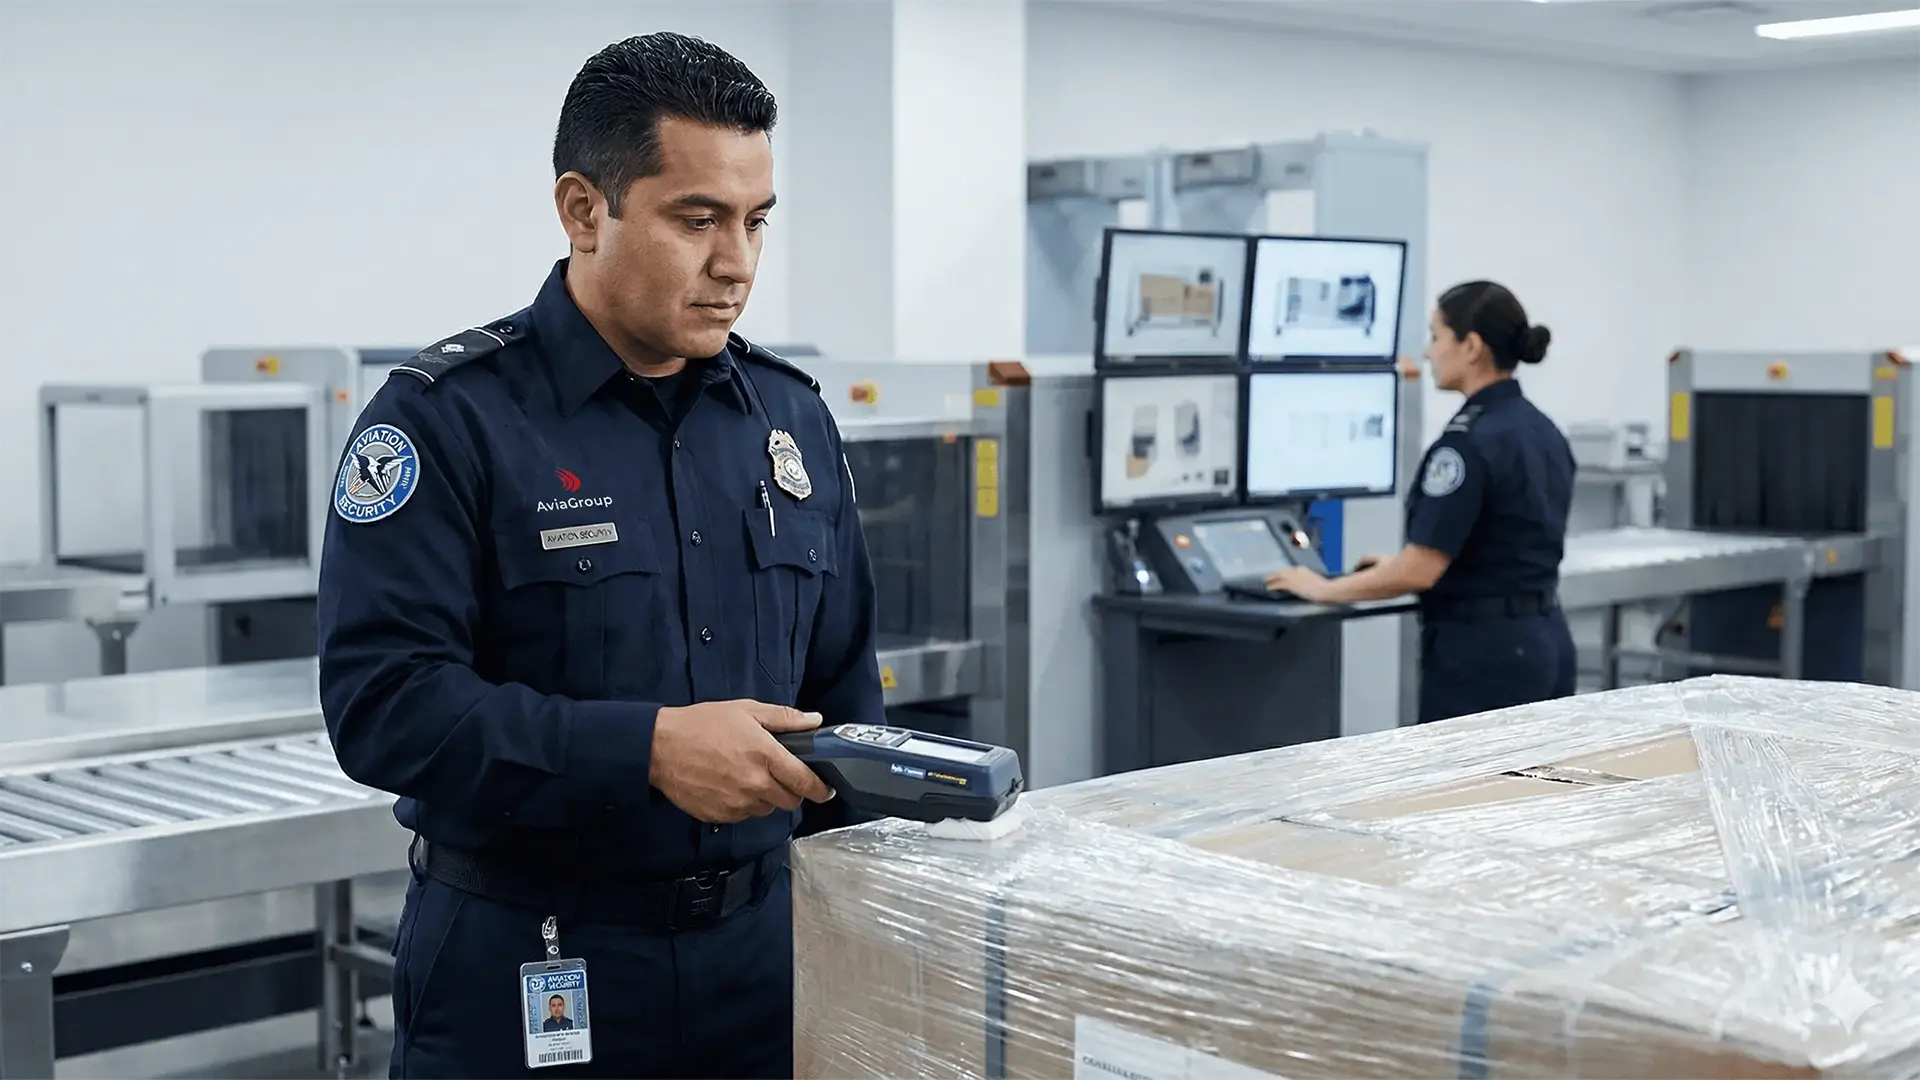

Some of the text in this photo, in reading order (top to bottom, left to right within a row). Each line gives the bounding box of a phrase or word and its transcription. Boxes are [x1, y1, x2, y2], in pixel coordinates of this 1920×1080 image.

[356, 429, 407, 454] AVIATION
[338, 494, 396, 517] SECURITY
[537, 496, 613, 512] AviaGroup
